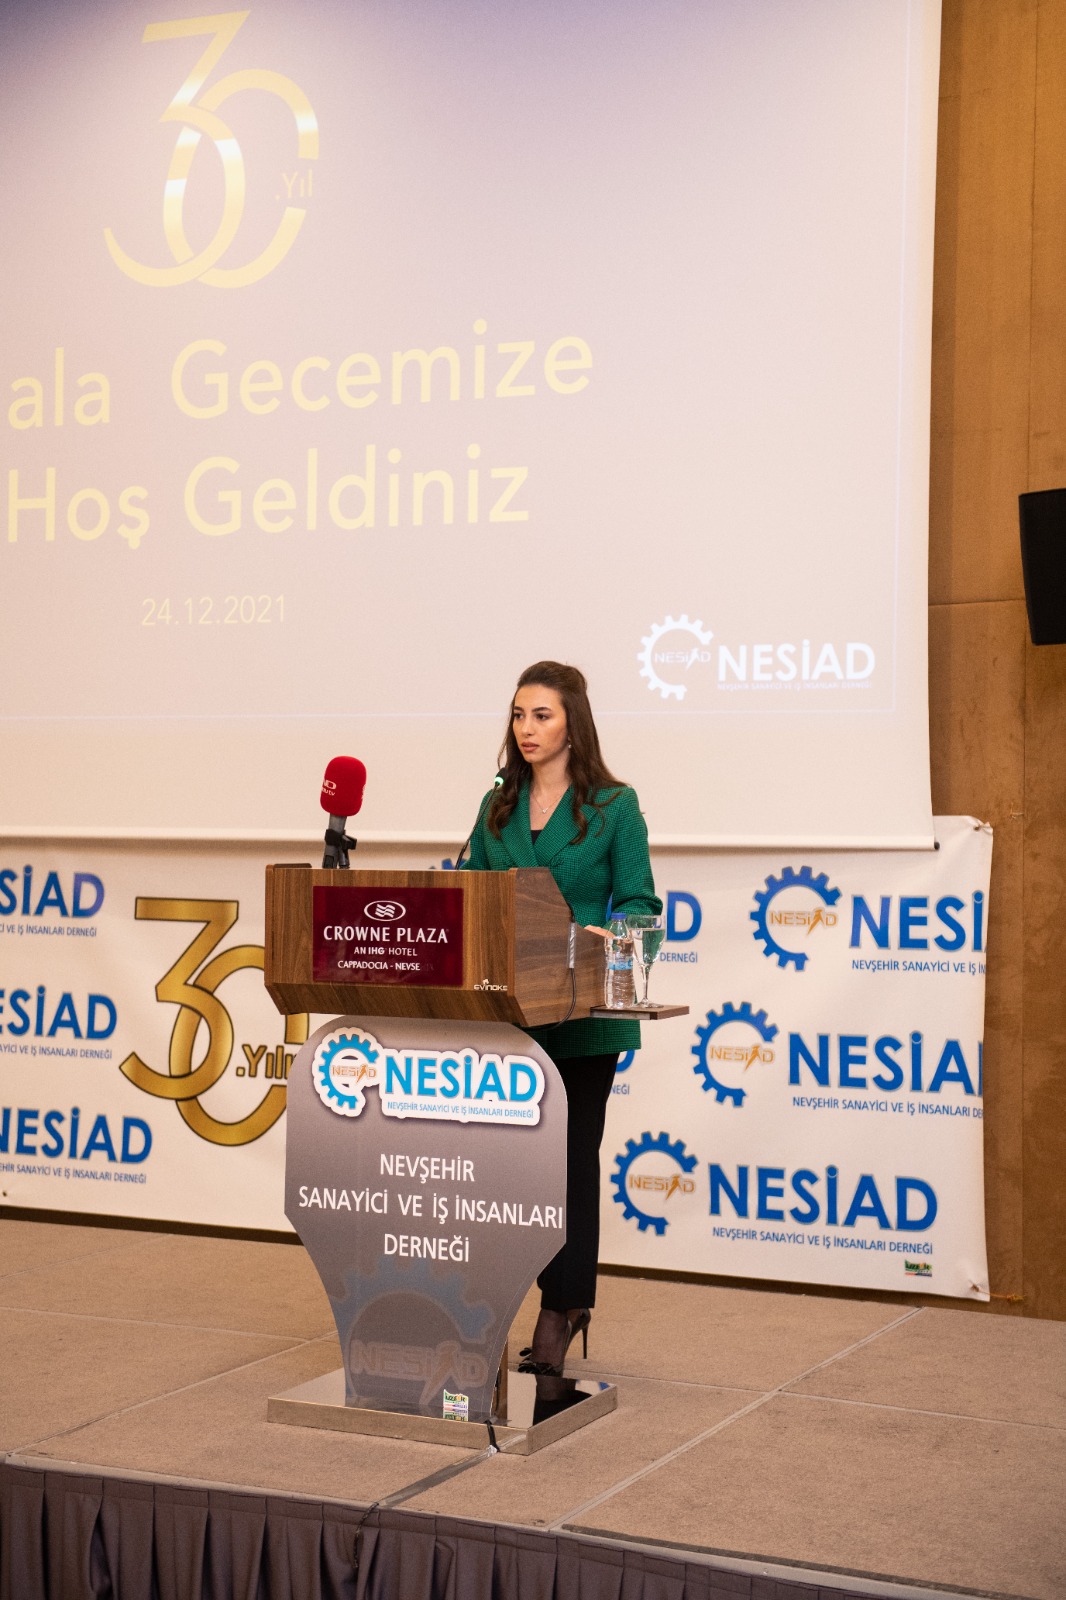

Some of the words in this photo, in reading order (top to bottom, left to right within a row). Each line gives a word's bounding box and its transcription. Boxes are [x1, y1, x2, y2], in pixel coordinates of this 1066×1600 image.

[171, 318, 594, 419] Gecemize
[7, 467, 151, 549] Hoş
[184, 443, 530, 536] Geldiniz
[142, 594, 286, 626] 24.12.2021
[718, 639, 876, 682] NESİAD
[6, 924, 15, 933] VE
[26, 923, 64, 935] İNSANLARI
[67, 926, 97, 936] DERNEĞİ
[323, 925, 391, 942] CROWNE
[396, 927, 448, 944] PLAZA
[849, 890, 986, 952] NESİ
[337, 960, 388, 970] CAPPADOCIA
[353, 947, 366, 955] AN
[368, 947, 385, 955] IHG
[388, 947, 418, 956] HOTEL
[660, 951, 698, 963] DERNEĞİ
[852, 959, 899, 973] NEVŞEHİR
[902, 960, 950, 972] SANAYİCİ
[953, 963, 965, 973] VE
[969, 961, 976, 975] İŞ
[0, 984, 117, 1040] SİAD
[20, 1045, 28, 1054] VE
[39, 1045, 77, 1057] İNSANLARI
[80, 1048, 112, 1059] DERNEĞİ
[788, 1030, 983, 1098] NESİA
[385, 1055, 537, 1102] NESİAD
[387, 1101, 418, 1112] NEVŞEHİR
[420, 1103, 450, 1113] SANAYİCİ
[451, 1105, 459, 1114] VE
[461, 1105, 467, 1116] İŞ
[468, 1106, 503, 1117] İNSANLARI
[504, 1108, 534, 1119] DERNEĞİ
[793, 1096, 839, 1110] NEVŞEHİR
[842, 1099, 888, 1112] SANAYİCİ
[891, 1103, 903, 1113] VE
[907, 1101, 915, 1116] İŞ
[918, 1102, 970, 1117] İNSANLARI
[17, 1164, 50, 1176] SANAYİCİ
[53, 1168, 62, 1177] VE
[73, 1169, 111, 1181] İNSANLARI
[114, 1173, 146, 1184] DERNEĞİ
[380, 1153, 475, 1184] NEVŞEHİR
[298, 1185, 388, 1214] SANAYİCİ
[398, 1193, 423, 1217] VE
[433, 1193, 449, 1225] İŞ
[455, 1194, 563, 1229] İNSANLARI
[708, 1163, 938, 1233] NESİAD
[384, 1233, 470, 1262] DERNEĞİ
[712, 1226, 758, 1241] NEVŞEHİR
[760, 1231, 805, 1244] SANAYİCİ
[808, 1235, 819, 1246] VE
[823, 1234, 831, 1249] İŞ
[834, 1235, 886, 1251] İNSANLARI
[889, 1241, 933, 1254] DERNEĞİ
